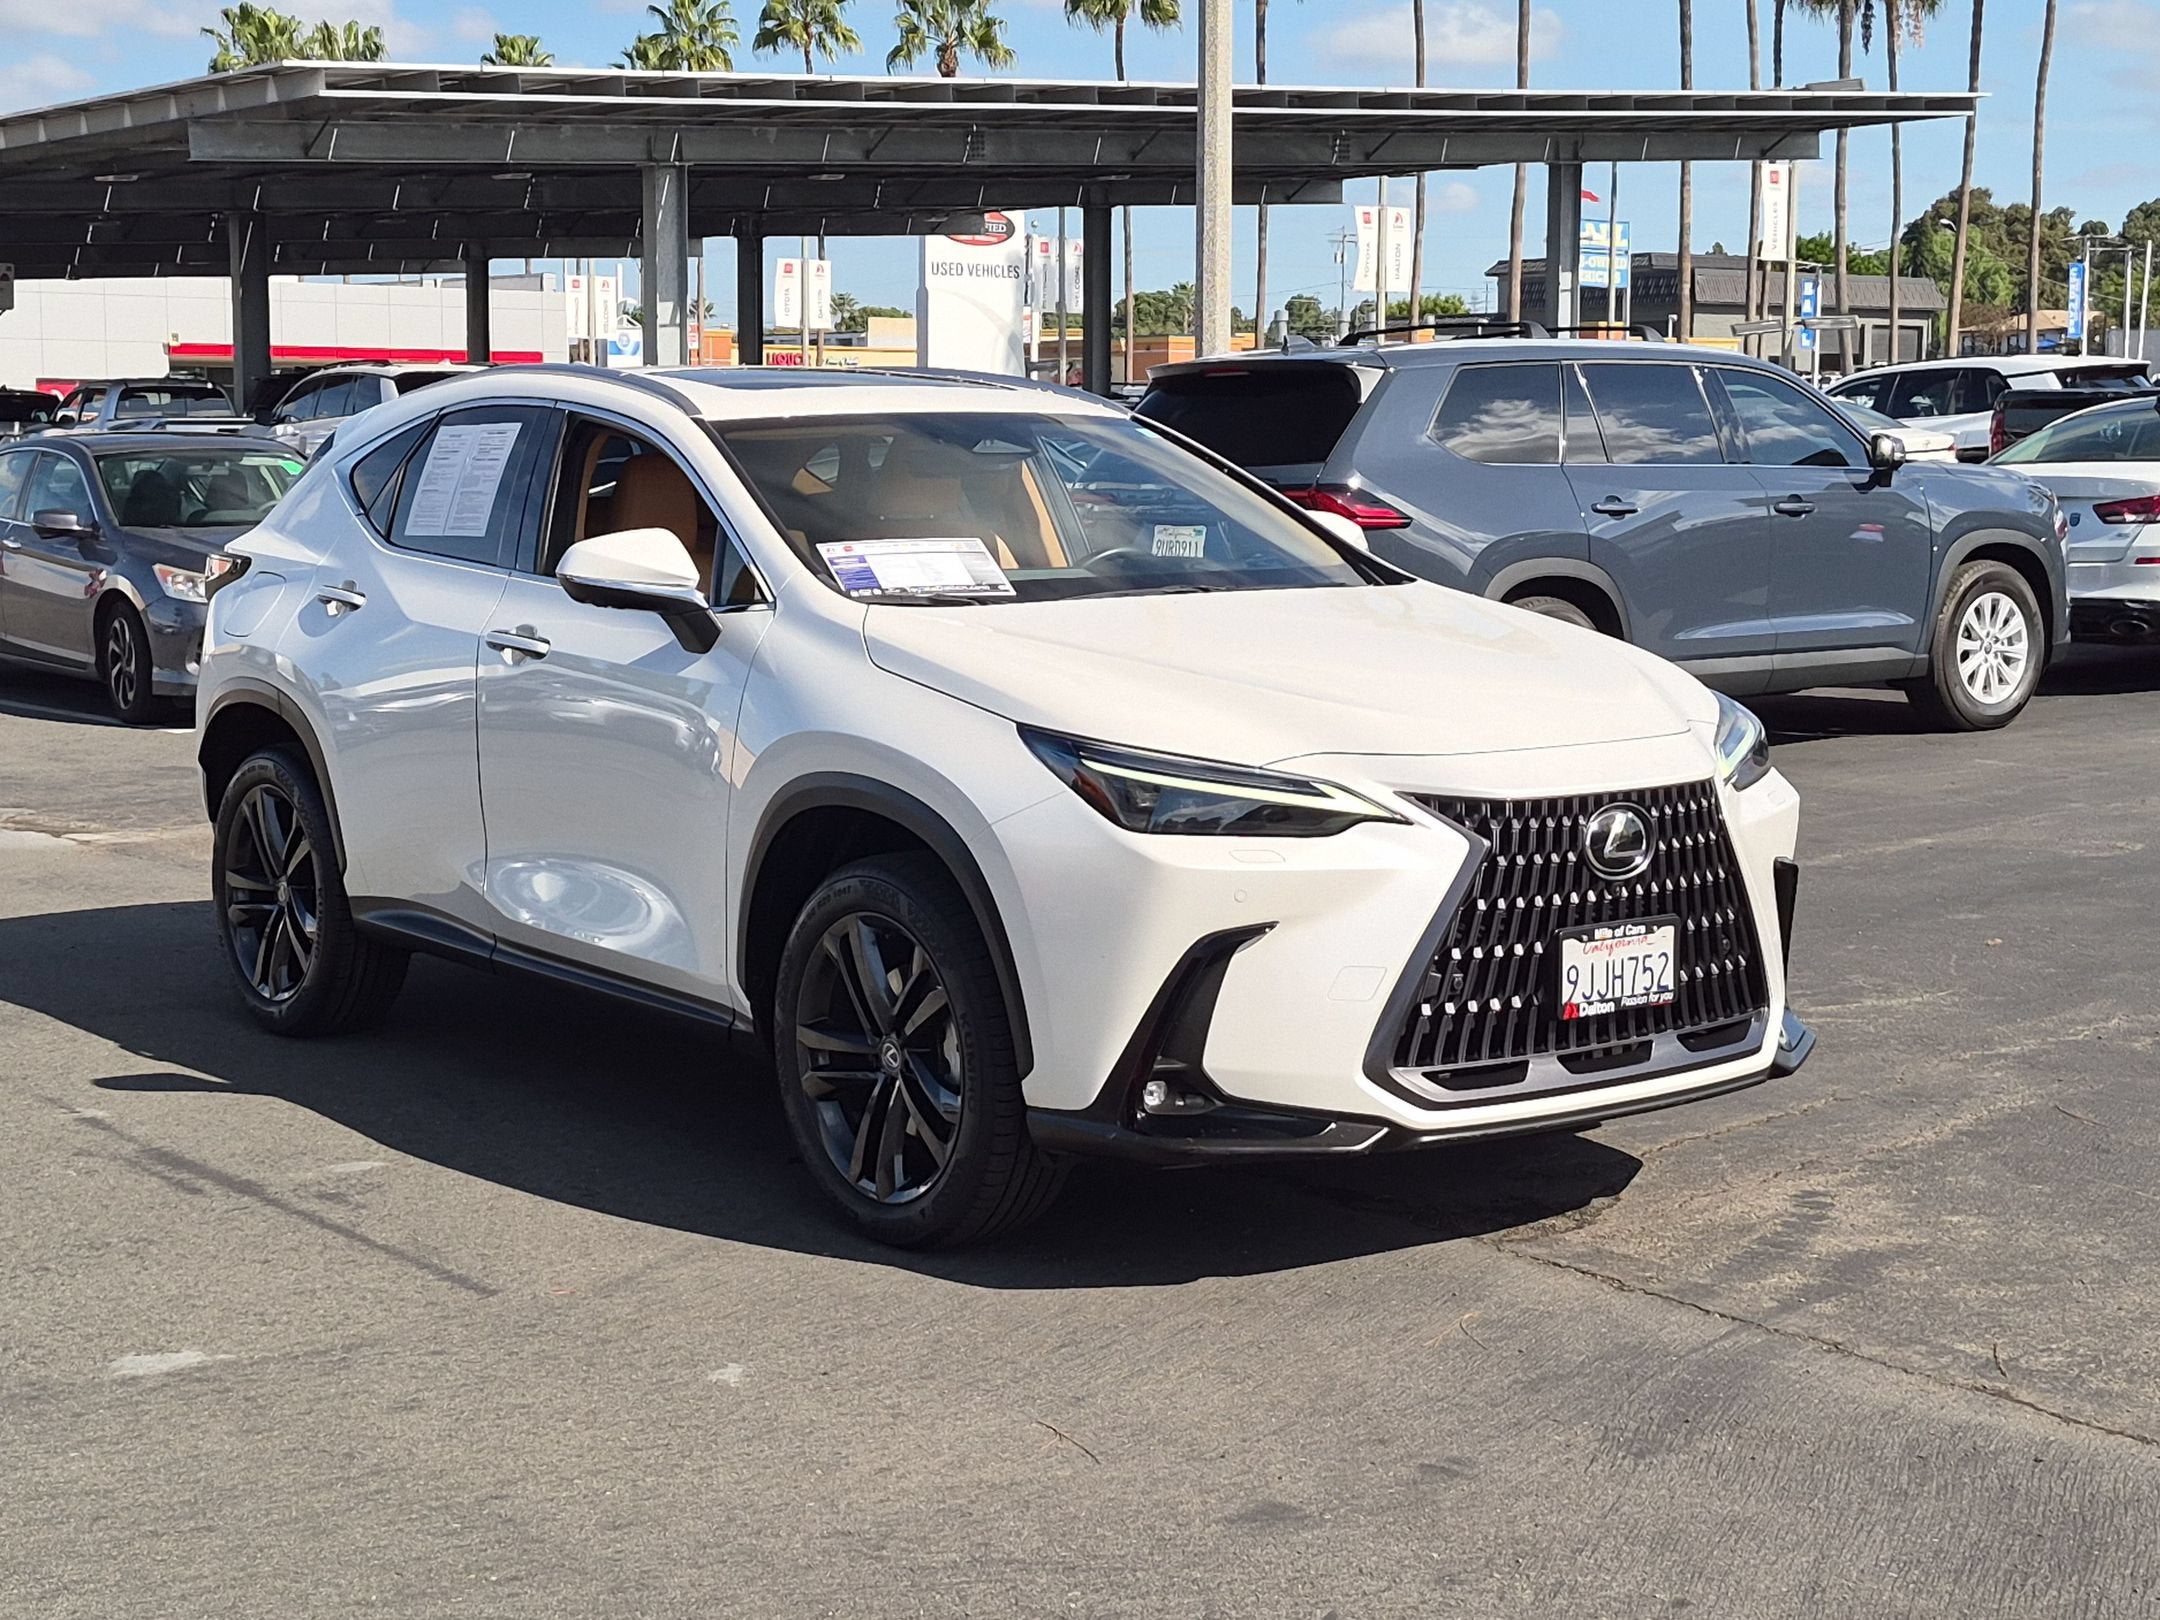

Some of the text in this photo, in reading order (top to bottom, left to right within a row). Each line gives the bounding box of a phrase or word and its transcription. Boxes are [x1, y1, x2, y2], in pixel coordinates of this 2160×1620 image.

[931, 262, 1020, 279] USED VEHICLES
[766, 352, 811, 367] LIQUO
[1614, 925, 1624, 937] of
[1625, 924, 1646, 936] Cars
[1583, 935, 1648, 957] California
[1566, 951, 1669, 1003] 9JJH752
[1579, 1001, 1615, 1018] Dalton
